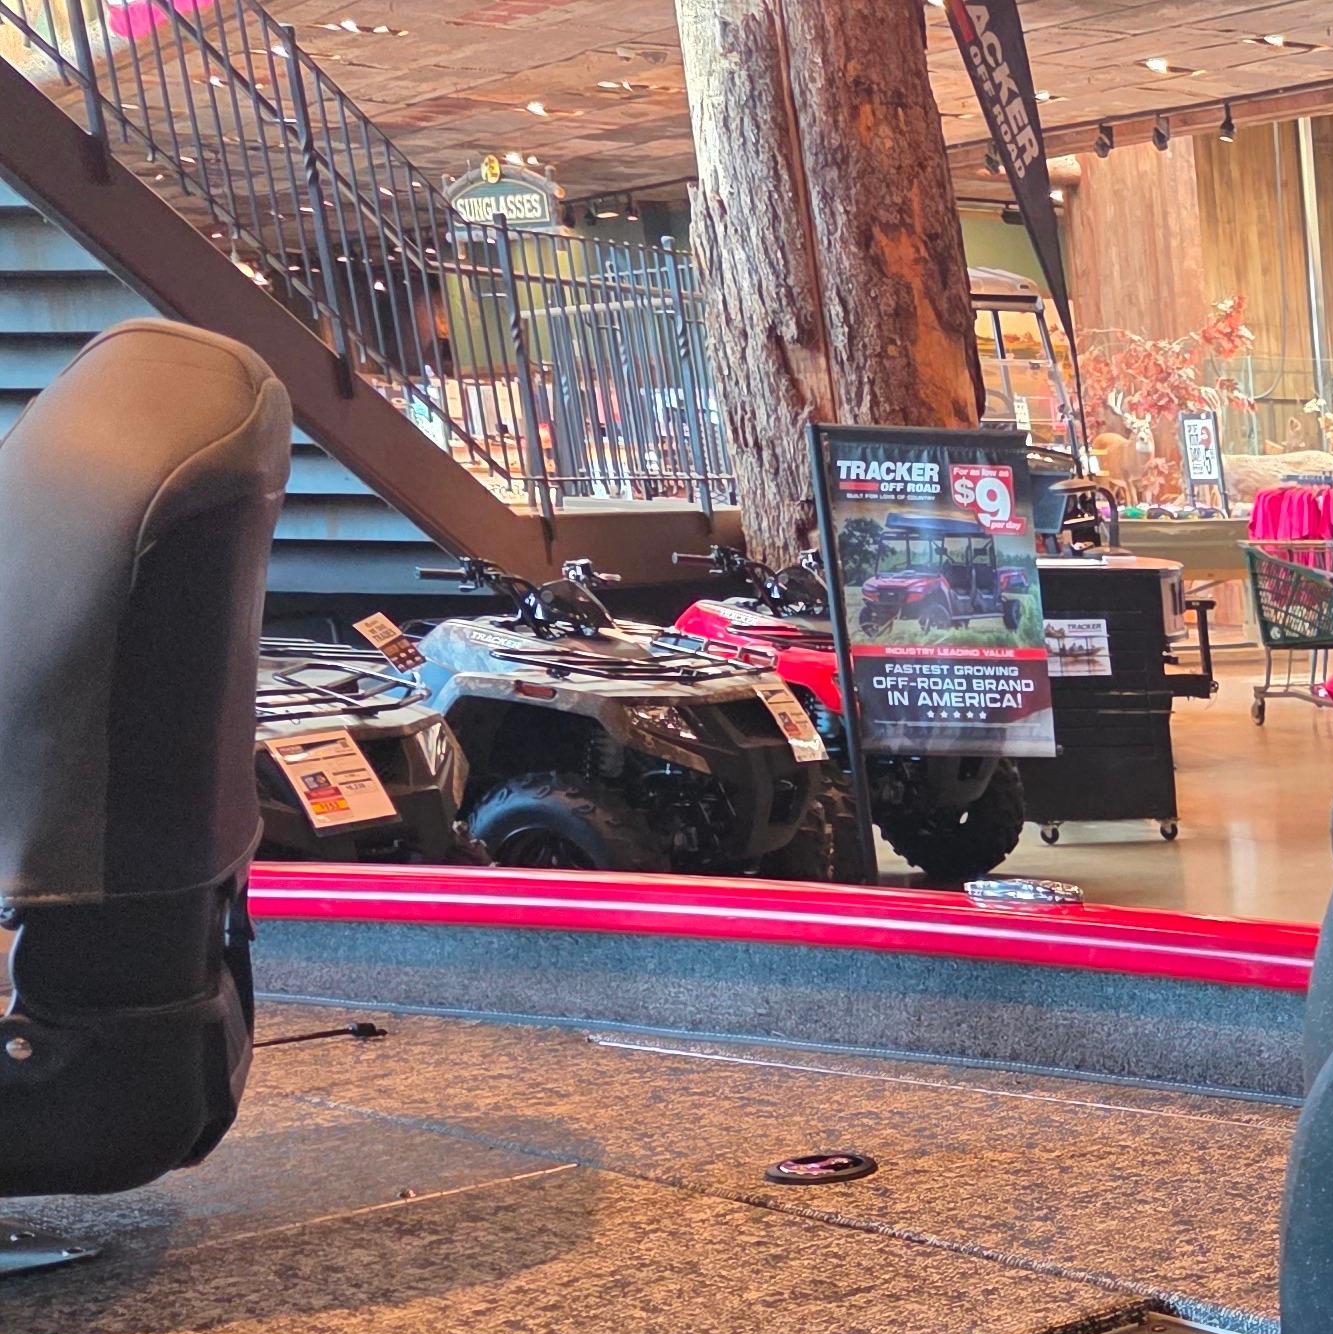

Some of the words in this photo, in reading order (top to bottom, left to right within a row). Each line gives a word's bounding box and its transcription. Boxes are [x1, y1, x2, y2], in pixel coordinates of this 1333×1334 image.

[969, 45, 995, 97] OFF
[992, 104, 1026, 179] ROAD
[457, 193, 541, 222] SUNGLASSES
[837, 460, 940, 482] TRACKER
[953, 467, 968, 476] For
[880, 483, 903, 492] OFF
[906, 484, 940, 493] ROAD
[954, 476, 1012, 523] $9
[990, 521, 1005, 531] per
[1006, 521, 1021, 531] day
[470, 630, 524, 650] TRACKER
[885, 647, 934, 656] INDUSTRY
[937, 648, 980, 657] LEADING
[984, 649, 1016, 658] VALUE
[885, 664, 949, 675] FASTEST
[954, 665, 1019, 677] GROWING
[873, 676, 966, 691] OFF-ROAD
[972, 679, 1035, 693] BRAND
[887, 690, 909, 706] IN
[917, 691, 1023, 709] AMERICA!
